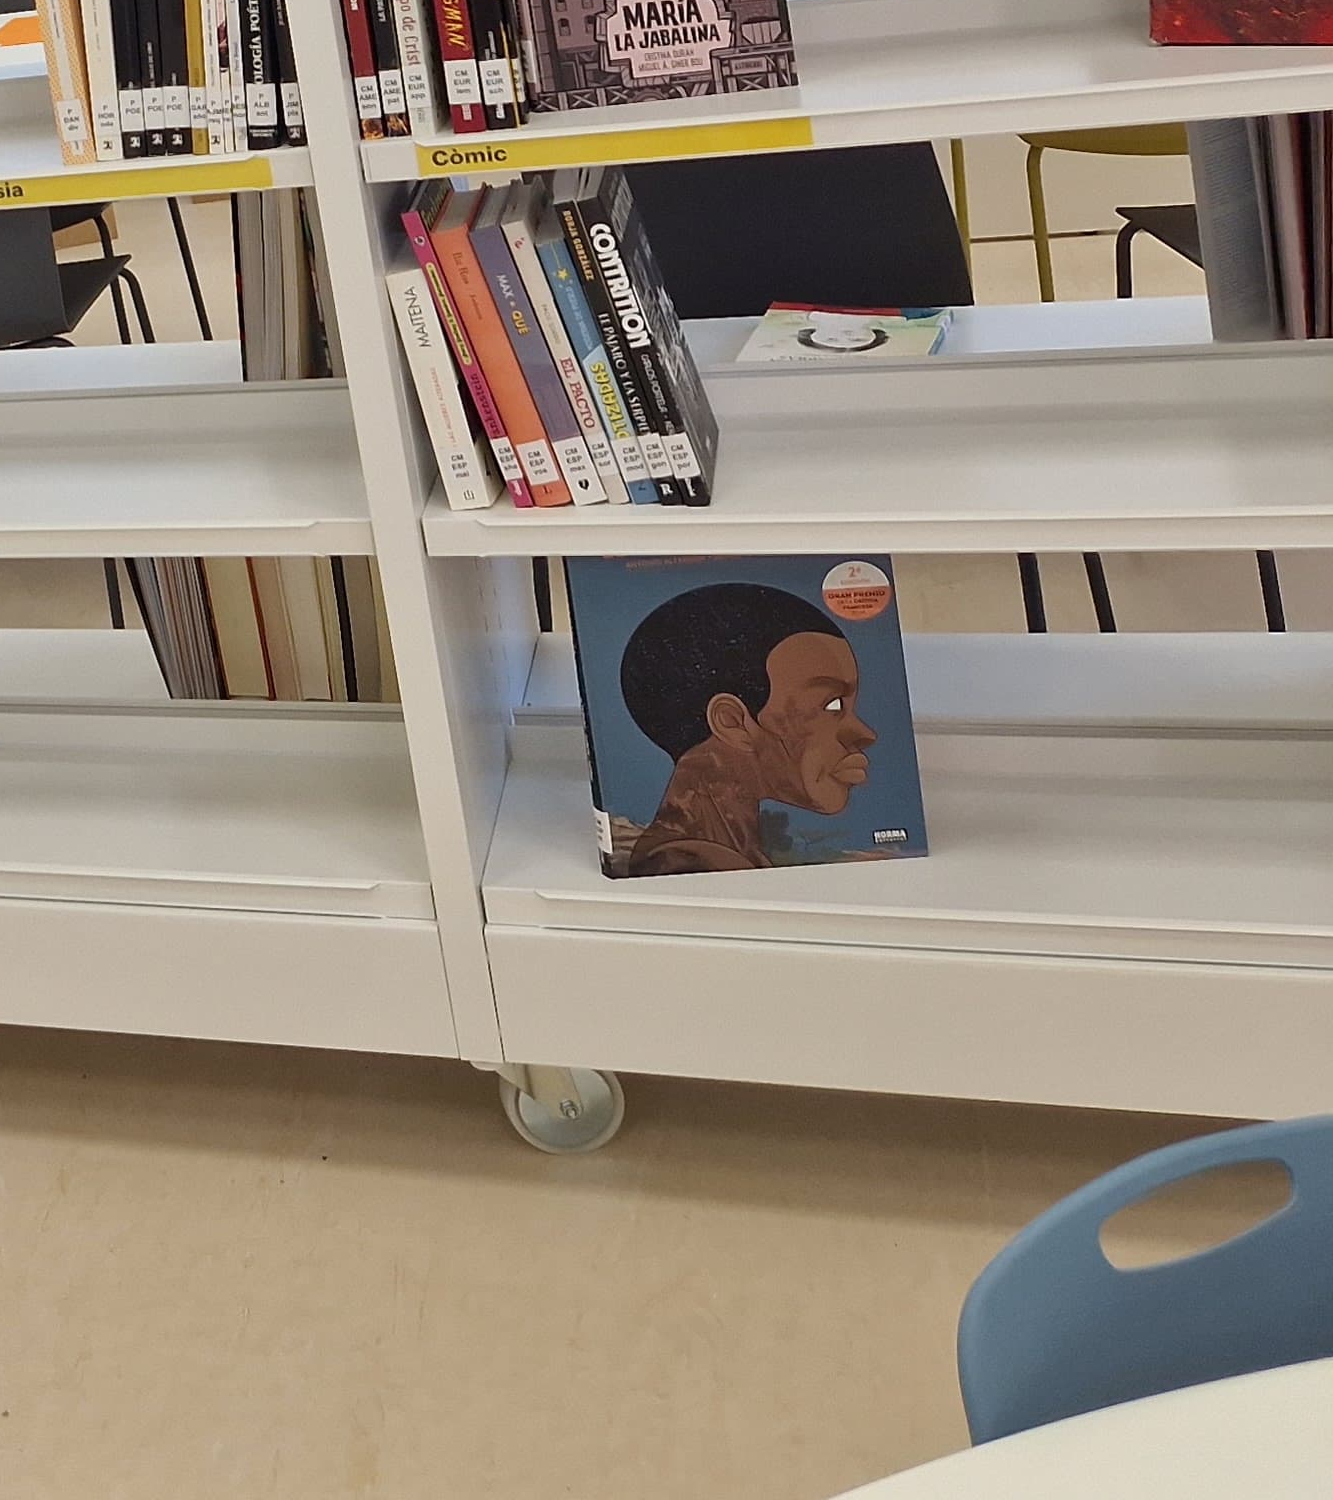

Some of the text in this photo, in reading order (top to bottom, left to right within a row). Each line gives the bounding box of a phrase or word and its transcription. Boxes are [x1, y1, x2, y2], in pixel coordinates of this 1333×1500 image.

[401, 13, 416, 31] de
[614, 23, 721, 51] LA JABALINA
[644, 50, 671, 62] CRISTINA
[638, 62, 661, 72] MIGUEL
[455, 69, 468, 77] CM
[486, 69, 500, 77] CM
[384, 79, 397, 87] CM
[454, 78, 471, 86] EUR
[486, 77, 504, 85] EUR
[361, 85, 373, 93] CM
[408, 83, 425, 91] EUR
[166, 103, 182, 111] POE
[254, 101, 270, 109] ALB
[125, 107, 141, 115] POE
[432, 146, 507, 166] Còmic
[562, 209, 596, 282] BORJA GONZÁLEZ
[590, 223, 651, 349] CONTRITION
[496, 274, 531, 335] MAX QUÉ
[404, 286, 431, 348] MAITENA
[597, 312, 610, 325] EL
[602, 325, 627, 369] PÁJARO
[623, 381, 637, 395] LA
[559, 357, 596, 429] EL PACTO
[628, 395, 651, 436] SERPIE
[498, 446, 511, 455] CM
[565, 447, 578, 455] CM
[592, 442, 605, 451] CM
[623, 446, 636, 455] CM
[646, 442, 660, 451] CM
[671, 444, 684, 452] CM
[451, 454, 464, 462] CM
[528, 450, 541, 459] CM
[593, 450, 609, 459] ESP
[623, 454, 640, 463] ESP
[647, 451, 664, 460] ESP
[672, 452, 689, 461] ESP
[500, 455, 515, 464] ESP
[529, 458, 545, 467] ESP
[566, 455, 582, 465] ESP
[452, 462, 468, 471] ESP
